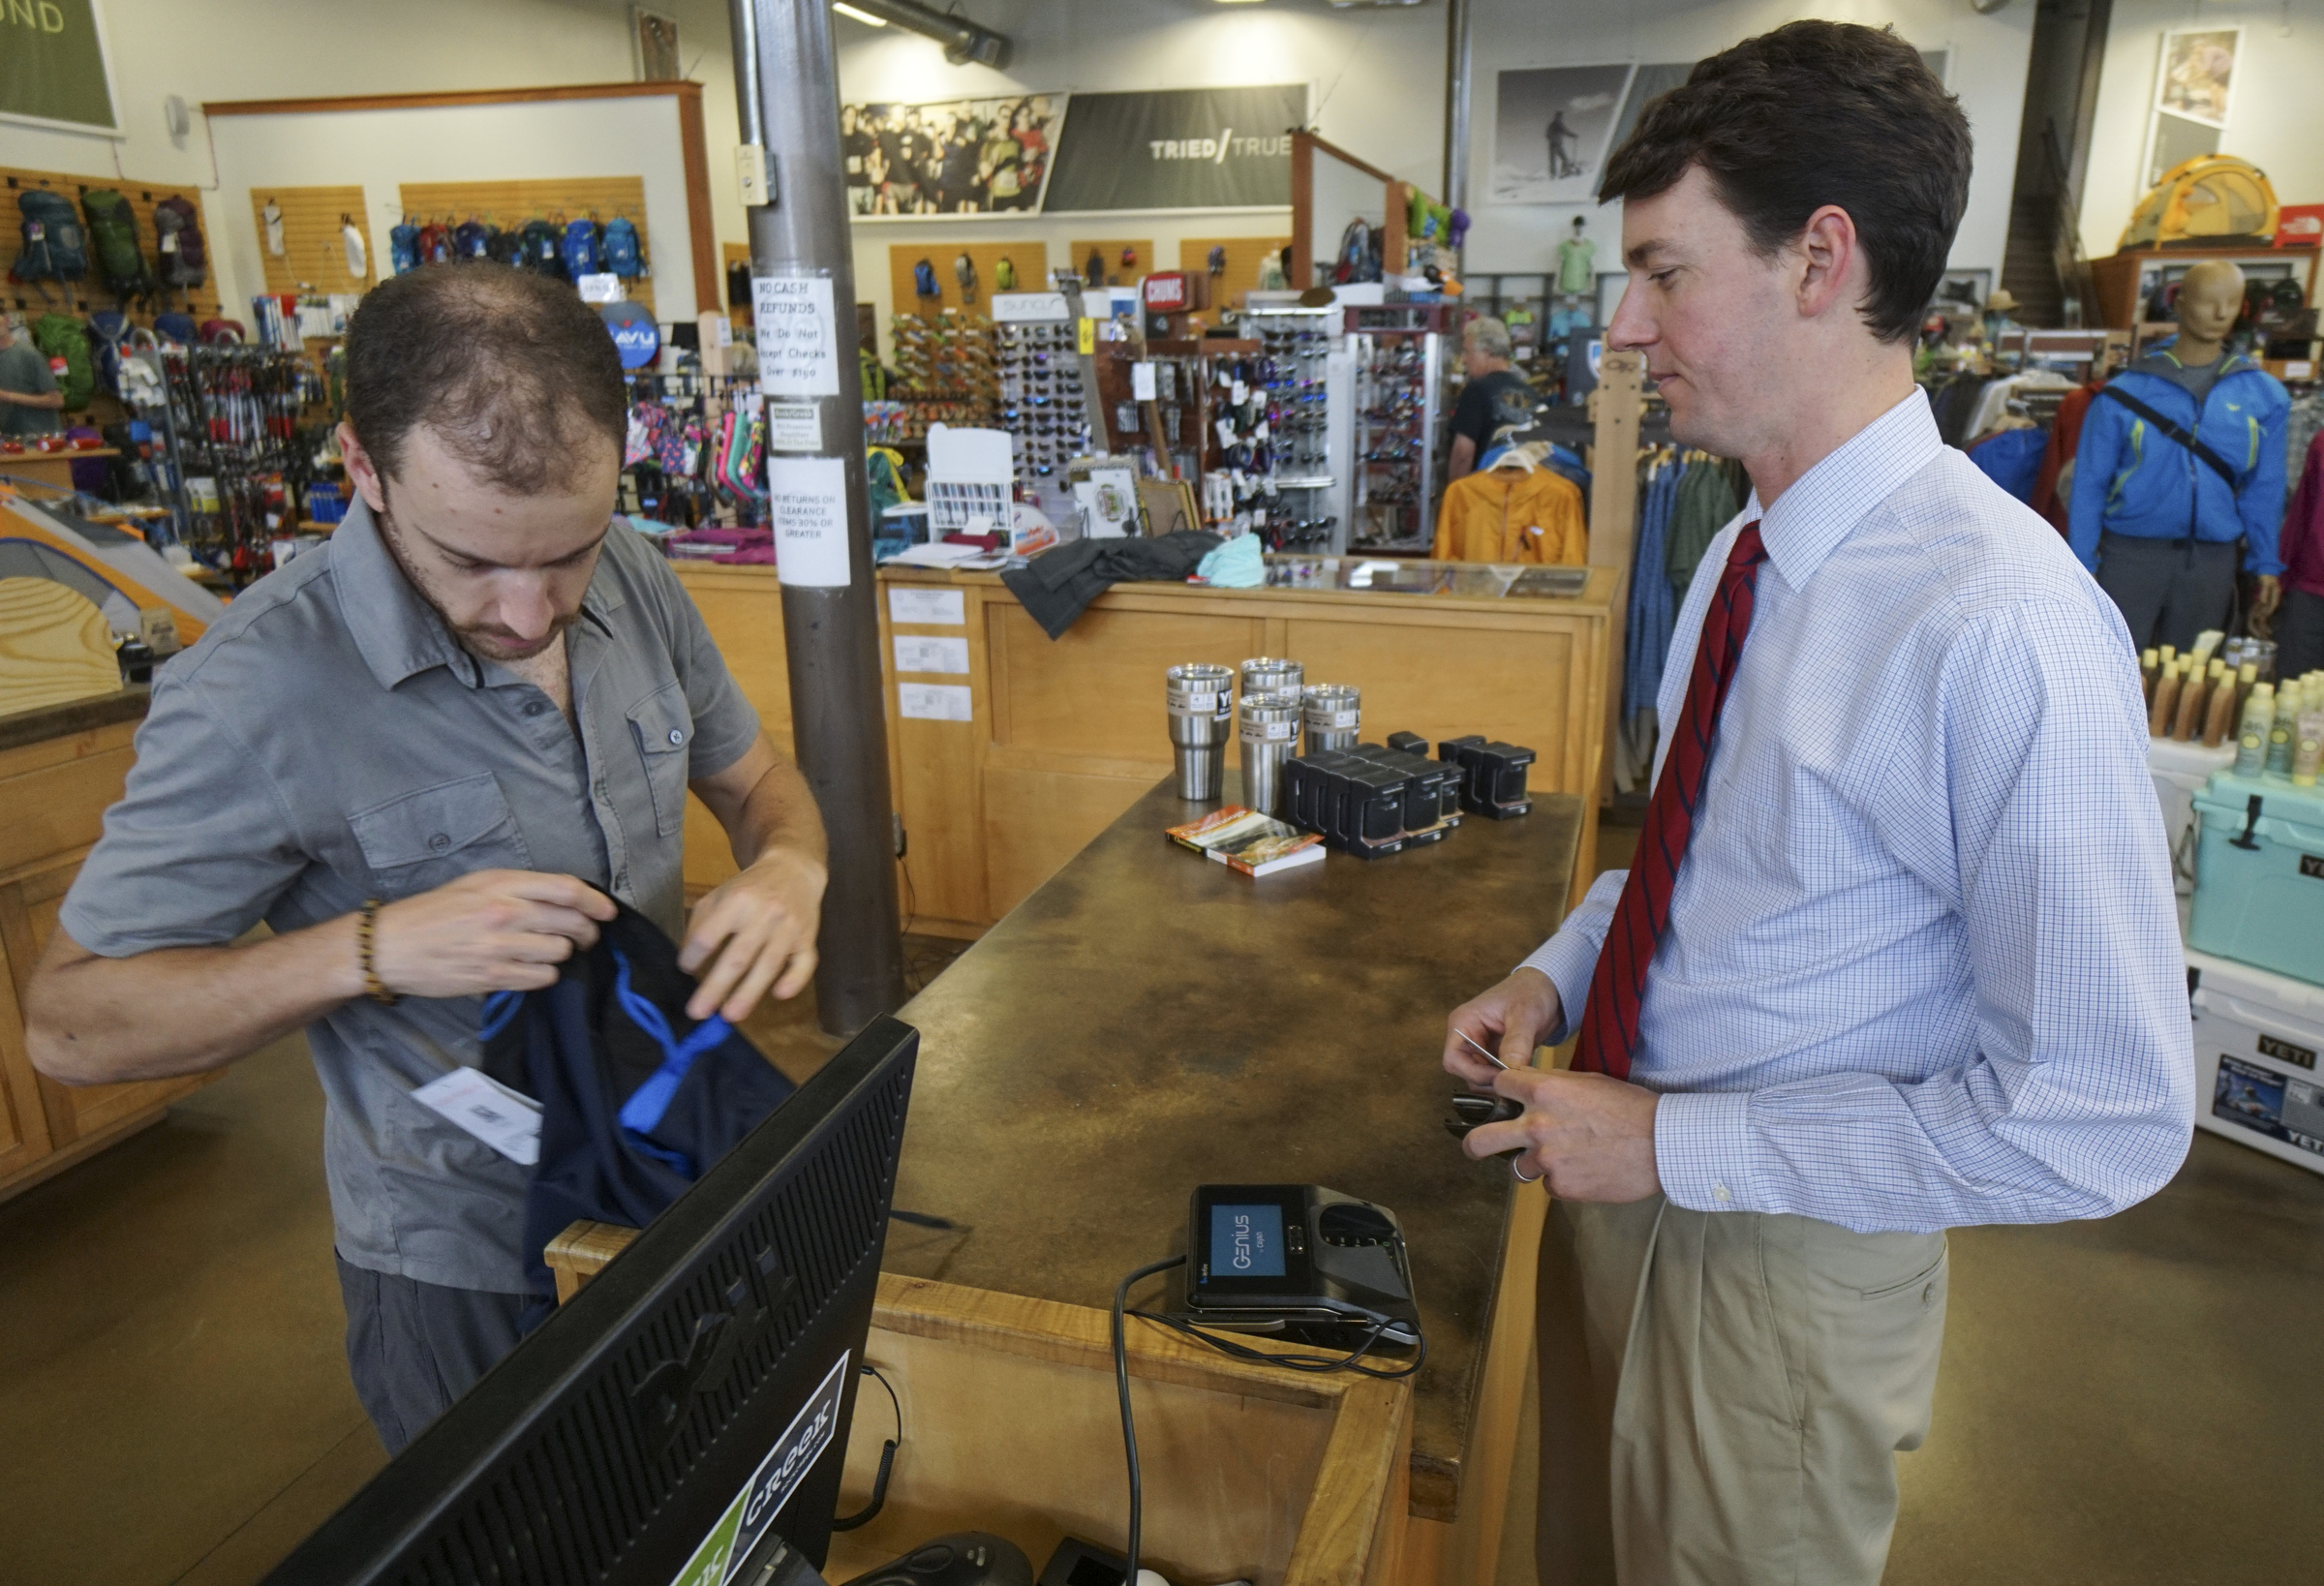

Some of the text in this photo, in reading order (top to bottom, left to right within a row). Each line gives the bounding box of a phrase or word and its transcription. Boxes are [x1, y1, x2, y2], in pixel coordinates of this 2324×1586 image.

[0, 0, 64, 33] ND
[759, 282, 809, 293] NO CASH
[1147, 278, 1183, 303] CHUMS
[760, 302, 815, 314] REFUNDS
[609, 329, 656, 345] AVU
[778, 329, 790, 338] Do
[798, 329, 818, 338] Not
[788, 349, 826, 359] Checks
[767, 366, 783, 376] Over
[782, 495, 820, 503] RETURNS
[822, 495, 836, 503] ON
[780, 506, 827, 515] CLEARANCE
[798, 518, 817, 527] 30%
[820, 518, 834, 527] OR
[785, 530, 822, 538] GREATER
[2264, 1038, 2312, 1066] YETI
[2288, 1129, 2324, 1150] YET
